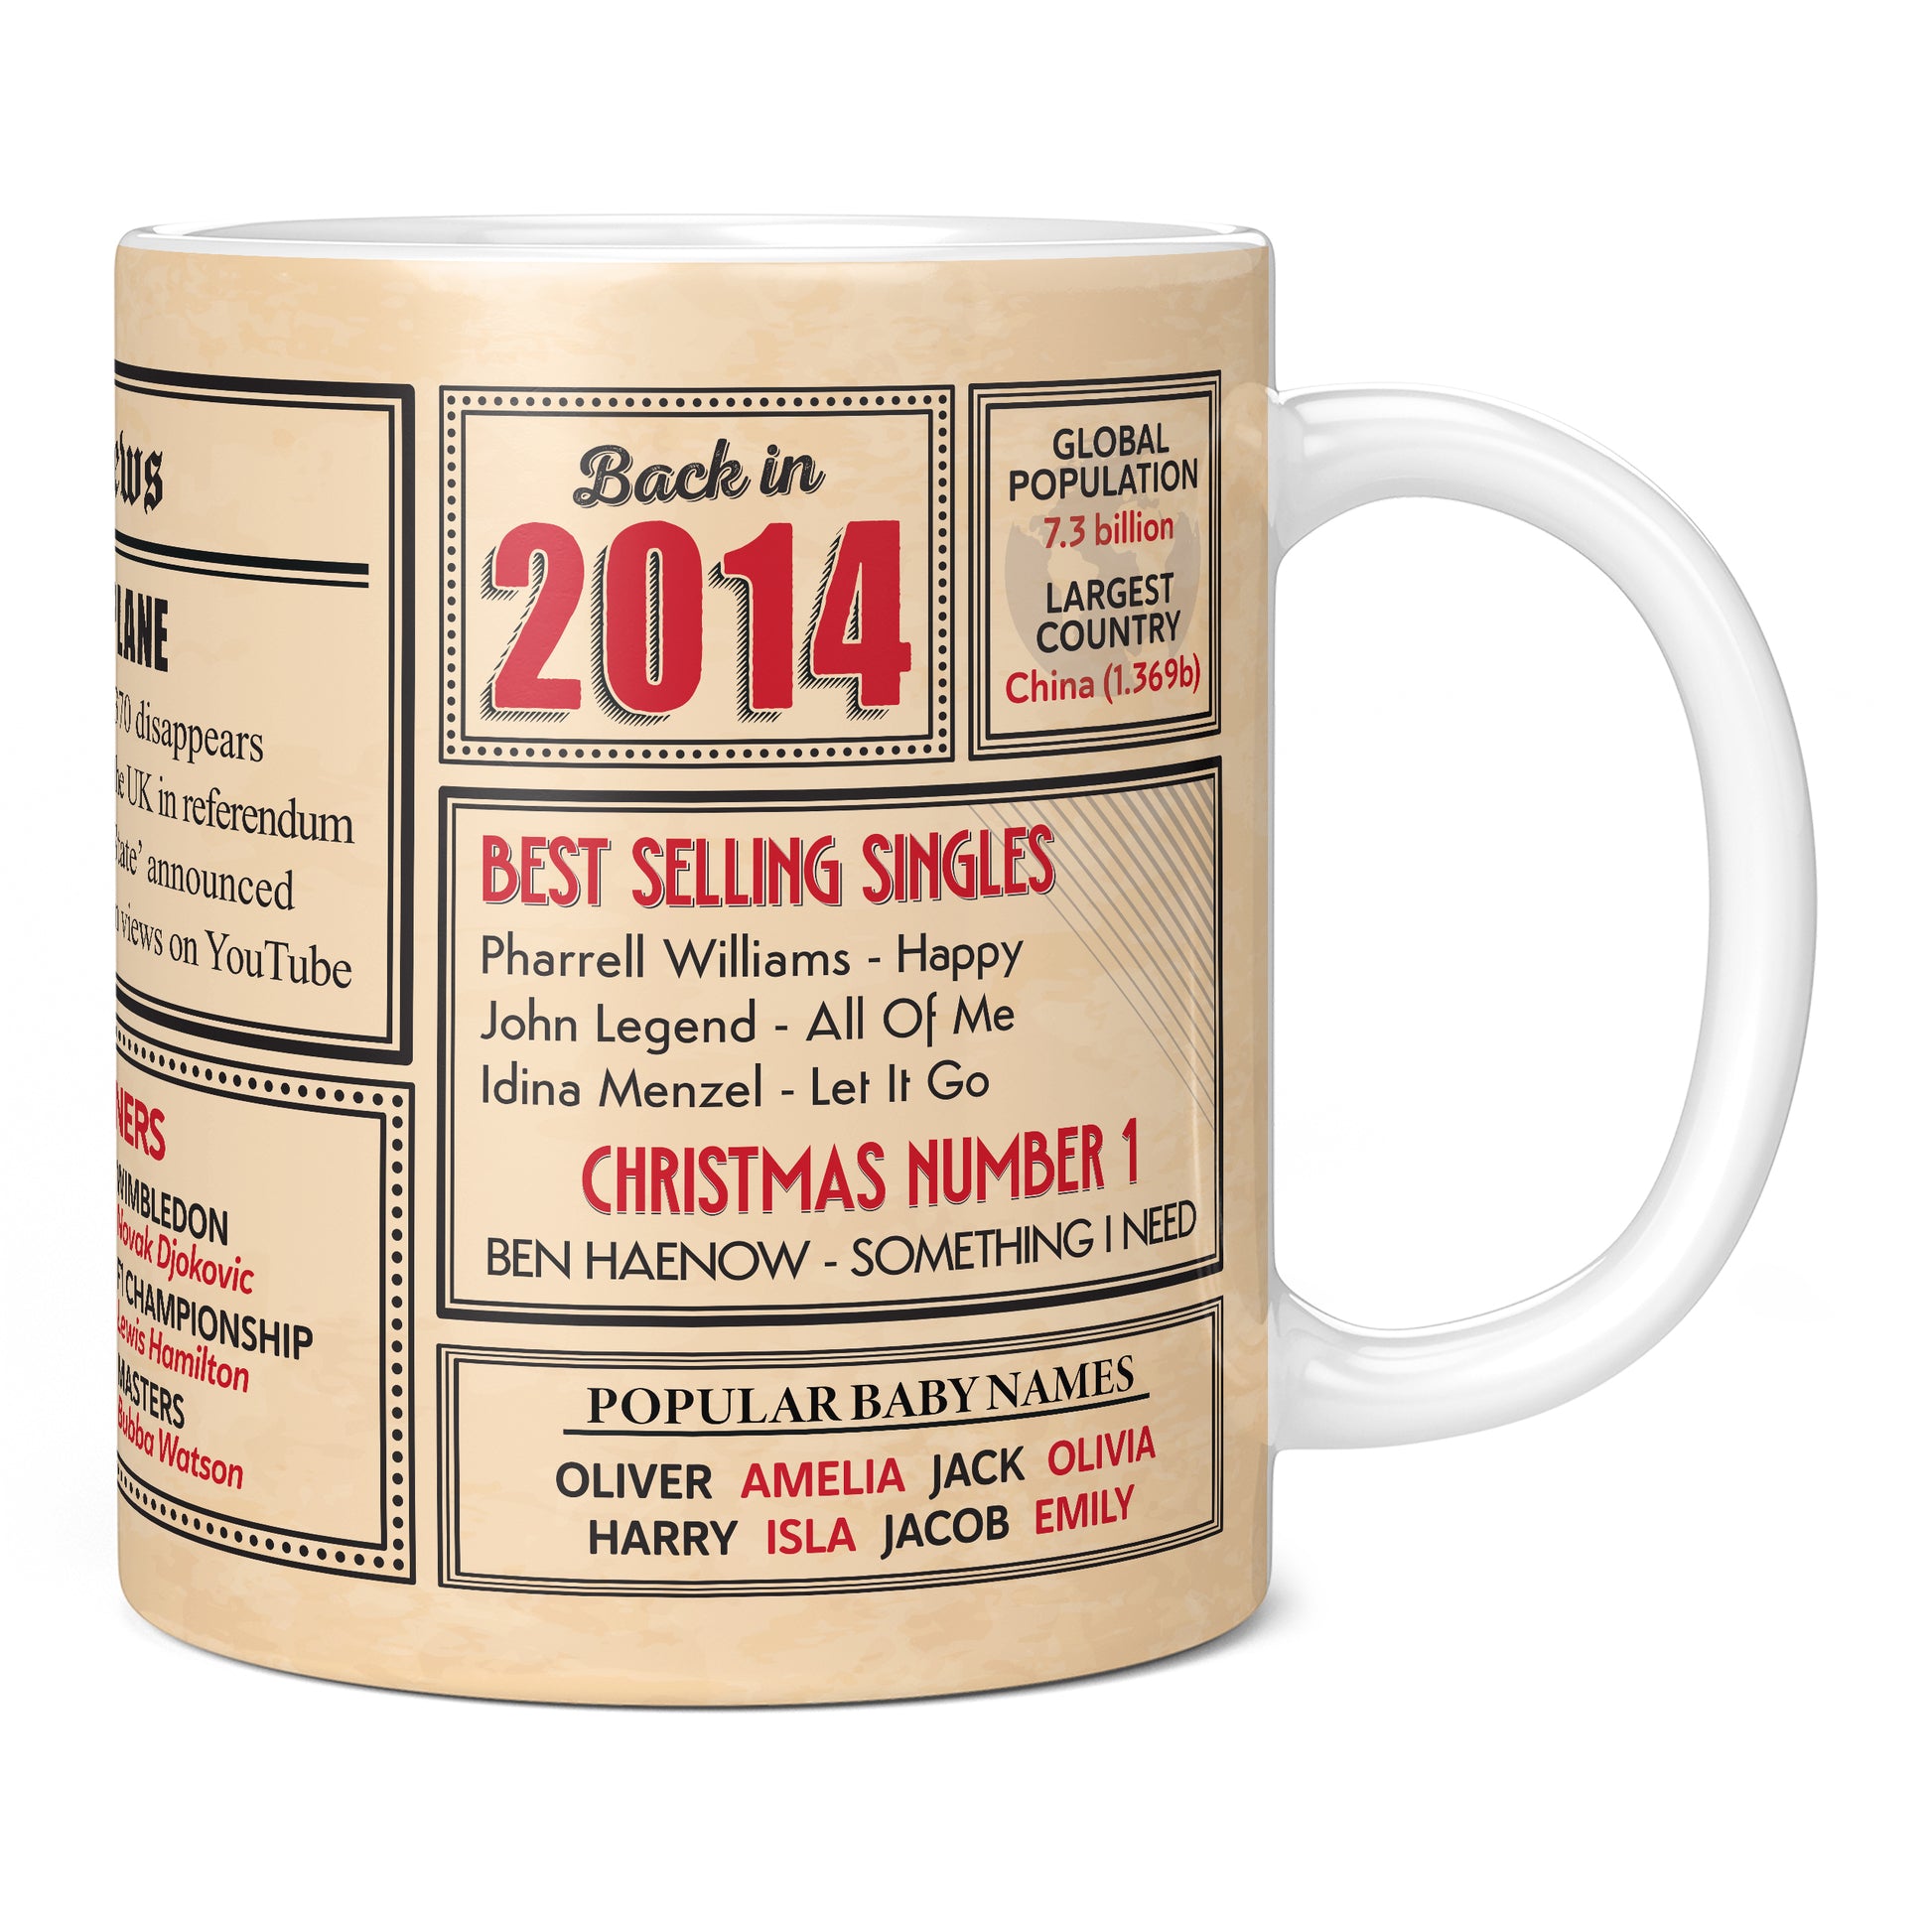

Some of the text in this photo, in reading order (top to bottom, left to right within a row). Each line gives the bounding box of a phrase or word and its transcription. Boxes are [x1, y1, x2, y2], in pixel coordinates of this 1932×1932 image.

[572, 438, 827, 509] Back in
[1009, 457, 1198, 502] POPULATION
[1052, 422, 1171, 461] GLOBAL
[1043, 509, 1174, 549] 7.3 billion
[114, 584, 169, 673] LANE
[481, 519, 912, 727] 2014
[1035, 609, 1181, 654] COUNTRY
[1046, 571, 1174, 615] LARGEST
[1005, 651, 1201, 705] China (1.369b)
[135, 699, 264, 764] disappears
[126, 764, 154, 813] UK
[158, 775, 179, 820] in
[182, 786, 355, 844] referendum
[147, 856, 295, 911] announced
[482, 823, 1056, 909] BEST SELLING SINGLES
[120, 902, 163, 956] views
[169, 933, 200, 967] on
[204, 929, 352, 989] YouTube
[483, 930, 644, 978] Pharrell
[662, 932, 851, 979] Williams
[897, 932, 1025, 982] Happy
[480, 996, 577, 1042] John
[597, 998, 756, 1055] Legend
[805, 995, 864, 1041] All
[883, 991, 937, 1048] Of
[952, 993, 1015, 1035] Me
[483, 1060, 580, 1107] Idina
[599, 1062, 761, 1108] Menzel
[812, 1066, 871, 1106] Let
[889, 1063, 911, 1103] It
[927, 1059, 990, 1101] Go
[116, 1159, 228, 1247] WIMBLEDON
[582, 1117, 1138, 1217] CHRISTMAS NUMBER 1
[116, 1202, 255, 1296] Novak Djokovic
[487, 1237, 571, 1280] BEN
[586, 1240, 811, 1282] HAENOW
[850, 1216, 1094, 1278] SOMETHING
[1105, 1214, 1112, 1253] I
[1123, 1199, 1197, 1250] NEED
[116, 1297, 250, 1394] Lewis Hamilton
[125, 1269, 314, 1361] CHAMPIONSHIP
[117, 1351, 186, 1430] MASTERS
[587, 1354, 1135, 1425] POPULAR BABY NAMES
[117, 1394, 244, 1490] Bubba Watson
[555, 1425, 1157, 1501] OLIVER AMELIA JACK OLIVIA
[589, 1483, 1135, 1561] HARRY ISLA JACOB EMILY
